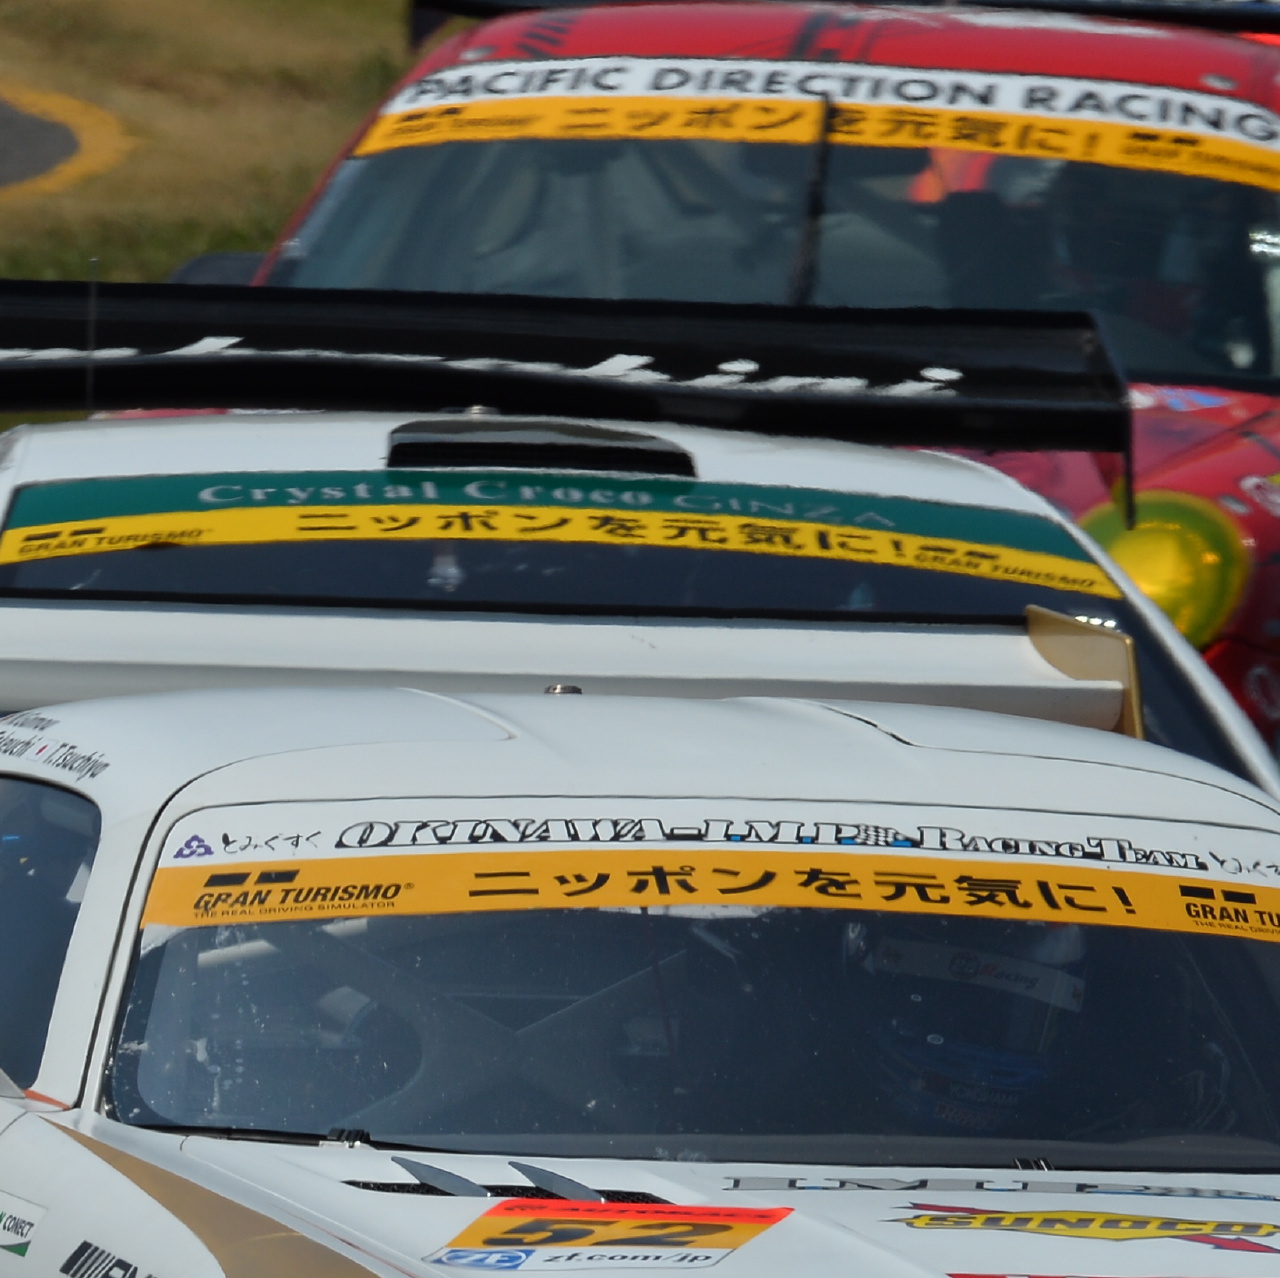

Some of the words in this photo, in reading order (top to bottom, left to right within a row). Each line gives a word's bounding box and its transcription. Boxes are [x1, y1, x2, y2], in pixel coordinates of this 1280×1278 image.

[412, 67, 628, 101] PACIFIC
[650, 66, 996, 106] DIRECTION
[1023, 85, 1280, 143] RACING
[197, 481, 438, 504] Crystal
[464, 480, 652, 506] Croco
[672, 495, 898, 528] GINZA
[18, 537, 89, 555] GRAN
[94, 528, 202, 548] TURISMO
[193, 889, 272, 910] GRAN
[193, 911, 218, 919] THE
[221, 909, 255, 917] REAL
[259, 905, 314, 915] DRIVING
[318, 901, 395, 911] SIMULATOR
[1185, 902, 1250, 924] GRAN
[481, 1217, 734, 1247] 52
[922, 1214, 1264, 1234] SUNOCO
[543, 1251, 713, 1264] zf.com/jp
